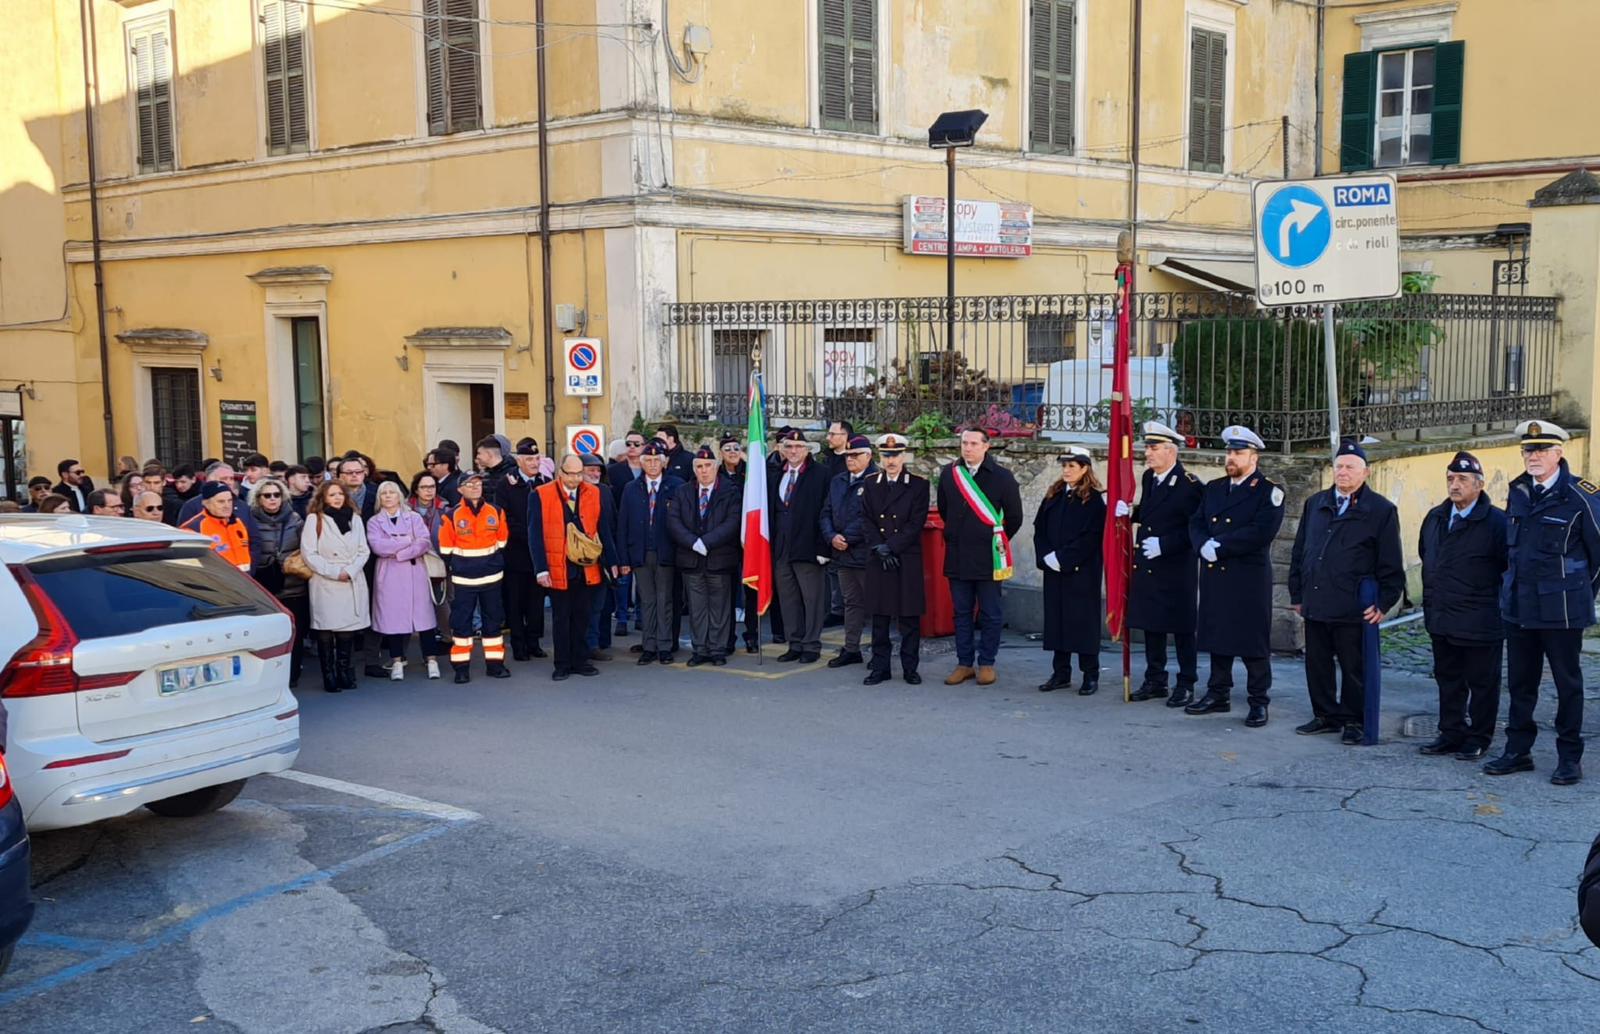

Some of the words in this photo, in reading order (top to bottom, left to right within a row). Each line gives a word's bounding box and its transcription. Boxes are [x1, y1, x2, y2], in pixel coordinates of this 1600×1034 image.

[1336, 186, 1388, 204] ROMA
[956, 203, 977, 220] opy
[1335, 213, 1396, 230] circ.ponente
[1366, 235, 1389, 250] rioli
[1274, 279, 1306, 296] 100
[1313, 283, 1325, 294] m
